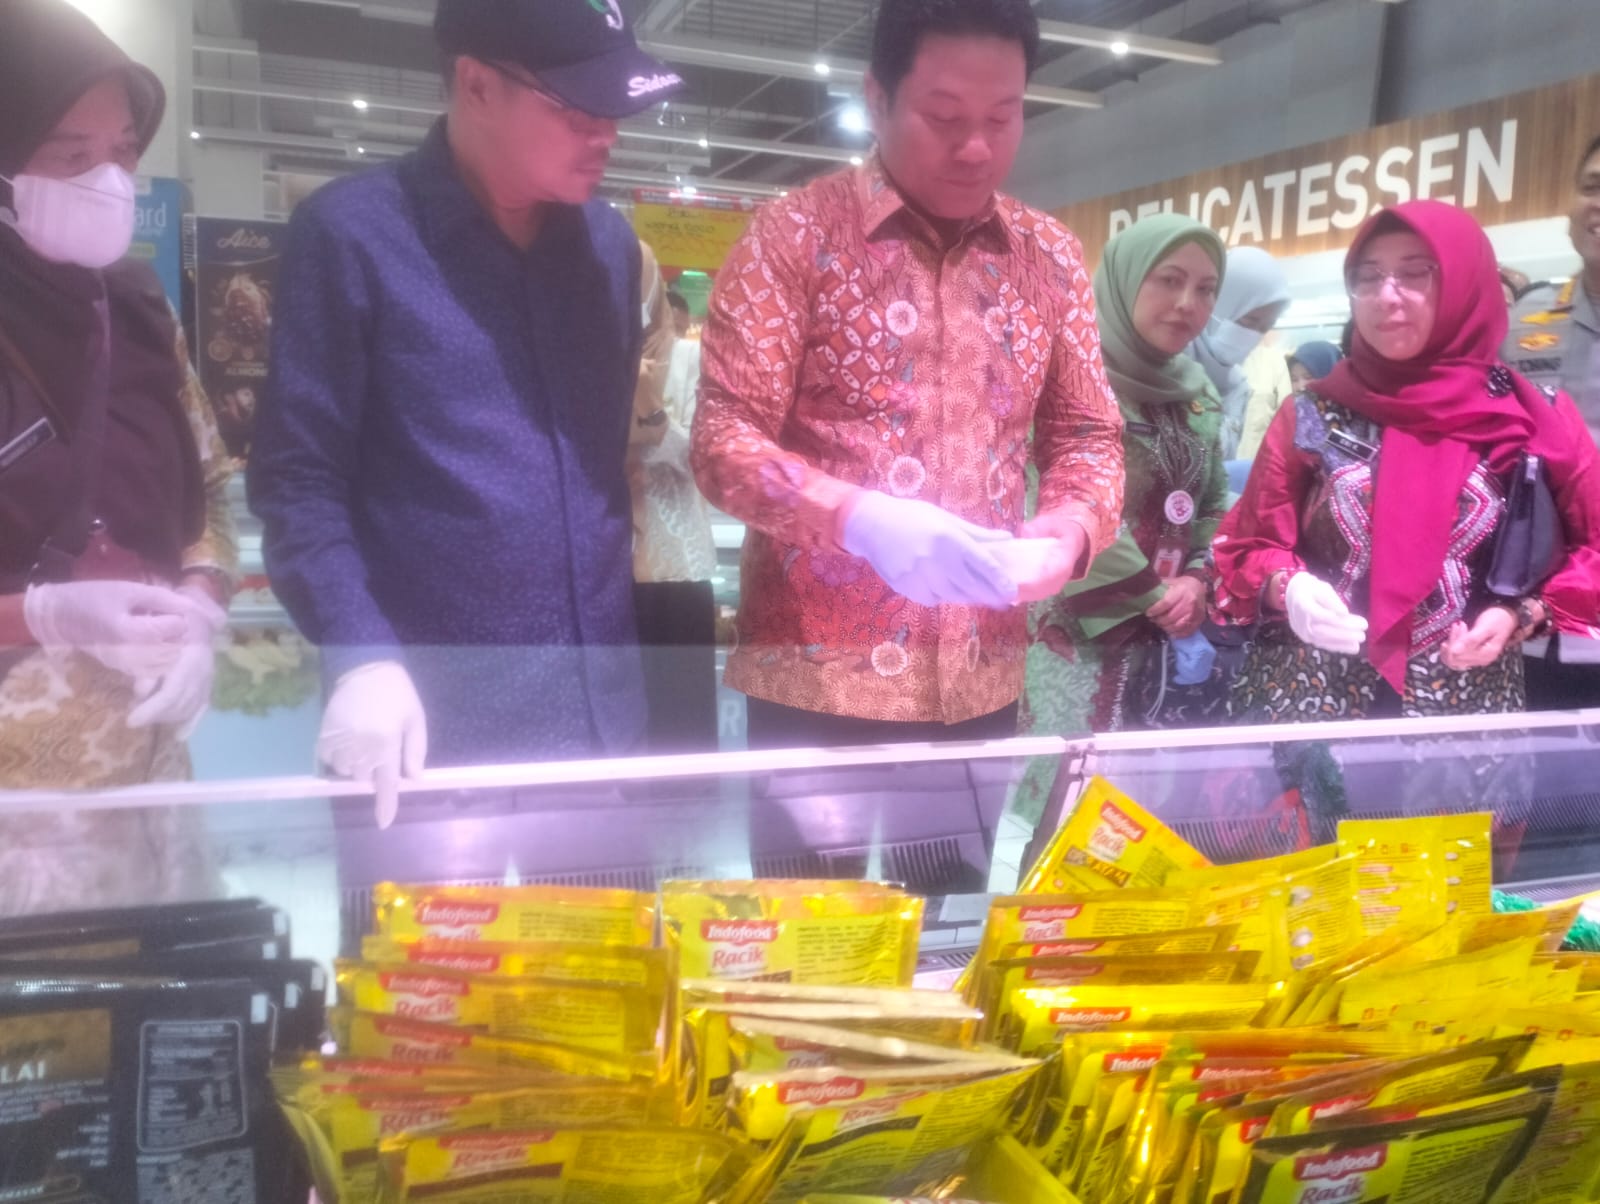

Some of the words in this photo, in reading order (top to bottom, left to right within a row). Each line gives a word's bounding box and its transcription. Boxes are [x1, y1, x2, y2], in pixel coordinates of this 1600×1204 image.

[1109, 119, 1518, 246] CATESSEN
[216, 228, 272, 249] Aice
[422, 905, 493, 925] Indofood
[707, 924, 773, 943] Indofood
[711, 946, 765, 969] Racik
[785, 1081, 859, 1103] Indofood
[1301, 1150, 1380, 1177] Indofood
[1298, 1176, 1363, 1204] Racik
